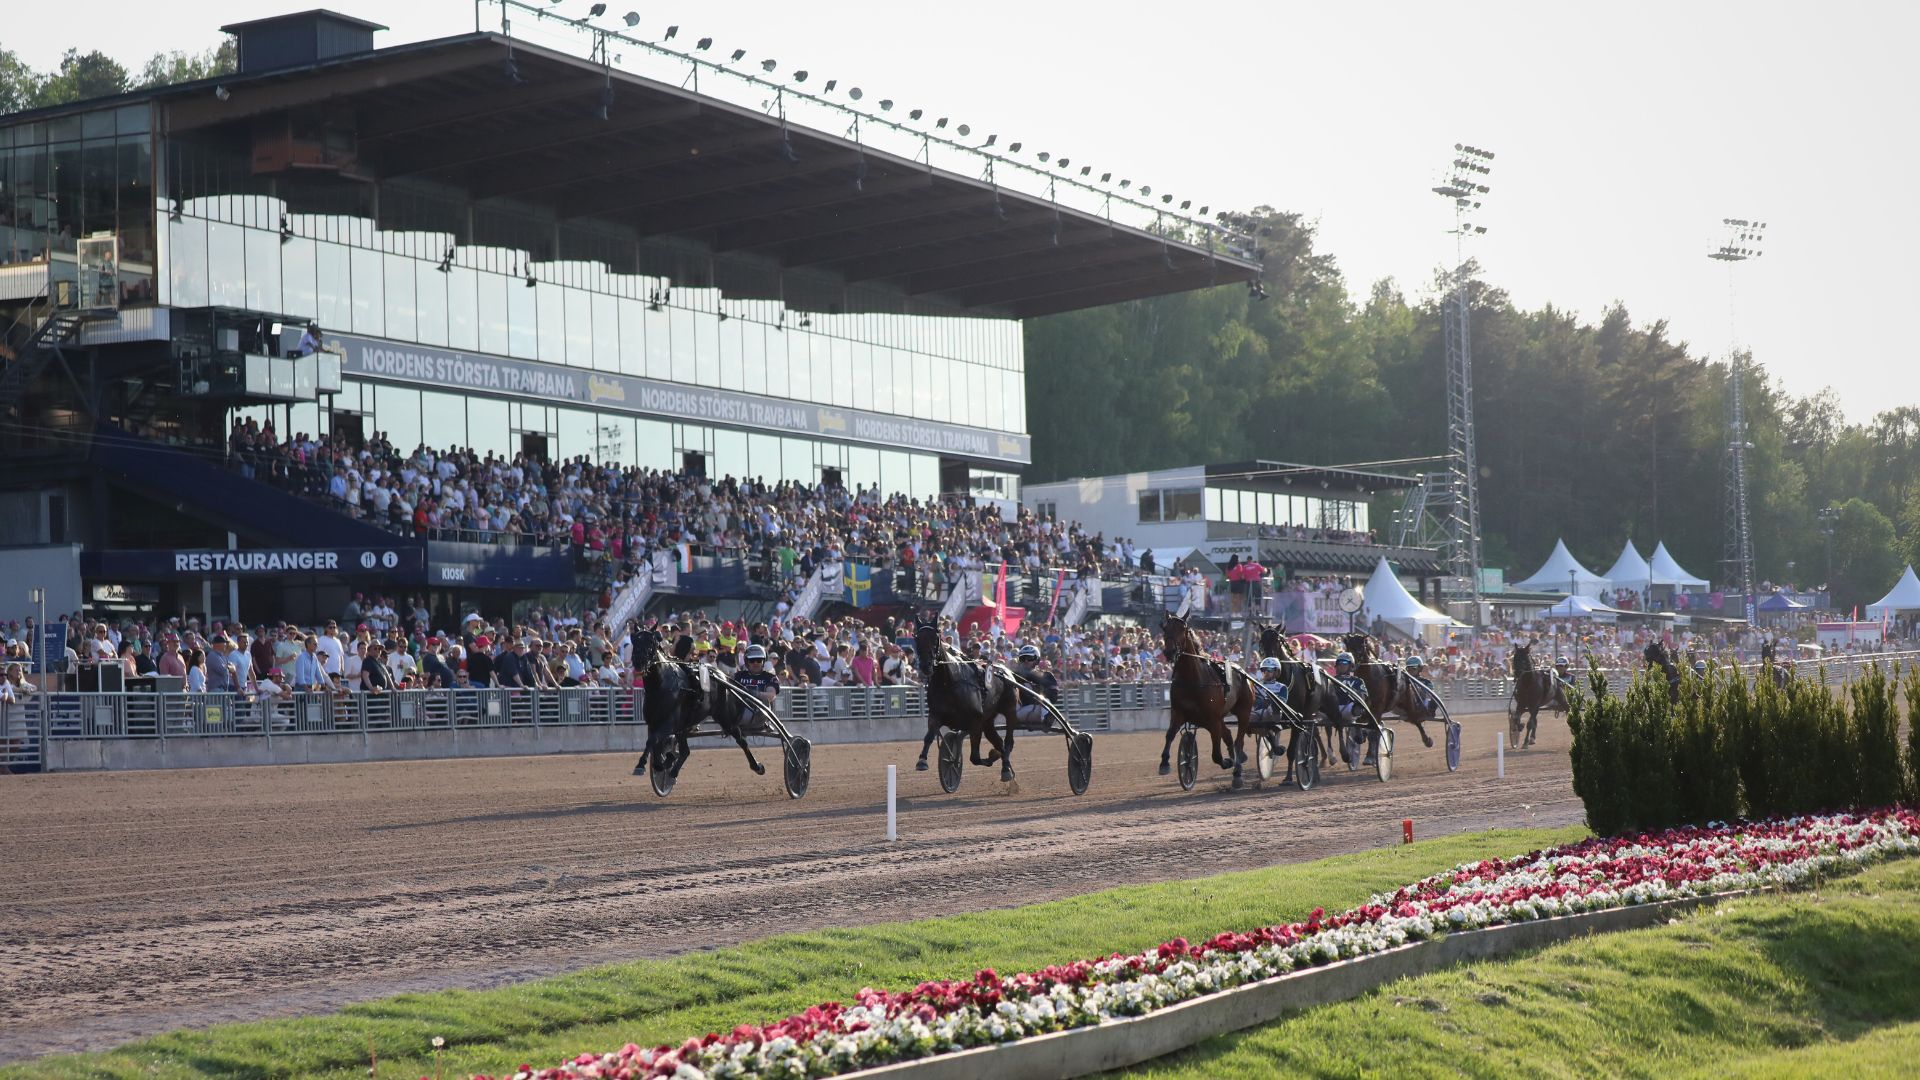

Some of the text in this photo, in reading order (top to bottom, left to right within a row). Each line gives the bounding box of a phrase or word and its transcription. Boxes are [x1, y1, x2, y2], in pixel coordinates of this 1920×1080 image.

[362, 347, 434, 378] NORDENS
[436, 354, 499, 388] STÖRSTA
[502, 367, 575, 397] TRAVBANA
[641, 388, 698, 414] NORDENS
[699, 392, 749, 422] STÖRSTA
[750, 404, 808, 429] TRAVBANA
[856, 418, 901, 442] NORDENS
[901, 421, 941, 448] STÖRSTA
[942, 434, 989, 454] TRAVBANA
[175, 552, 338, 571] RESTAURANGER
[441, 567, 465, 581] KIOSK
[986, 665, 993, 683] 6
